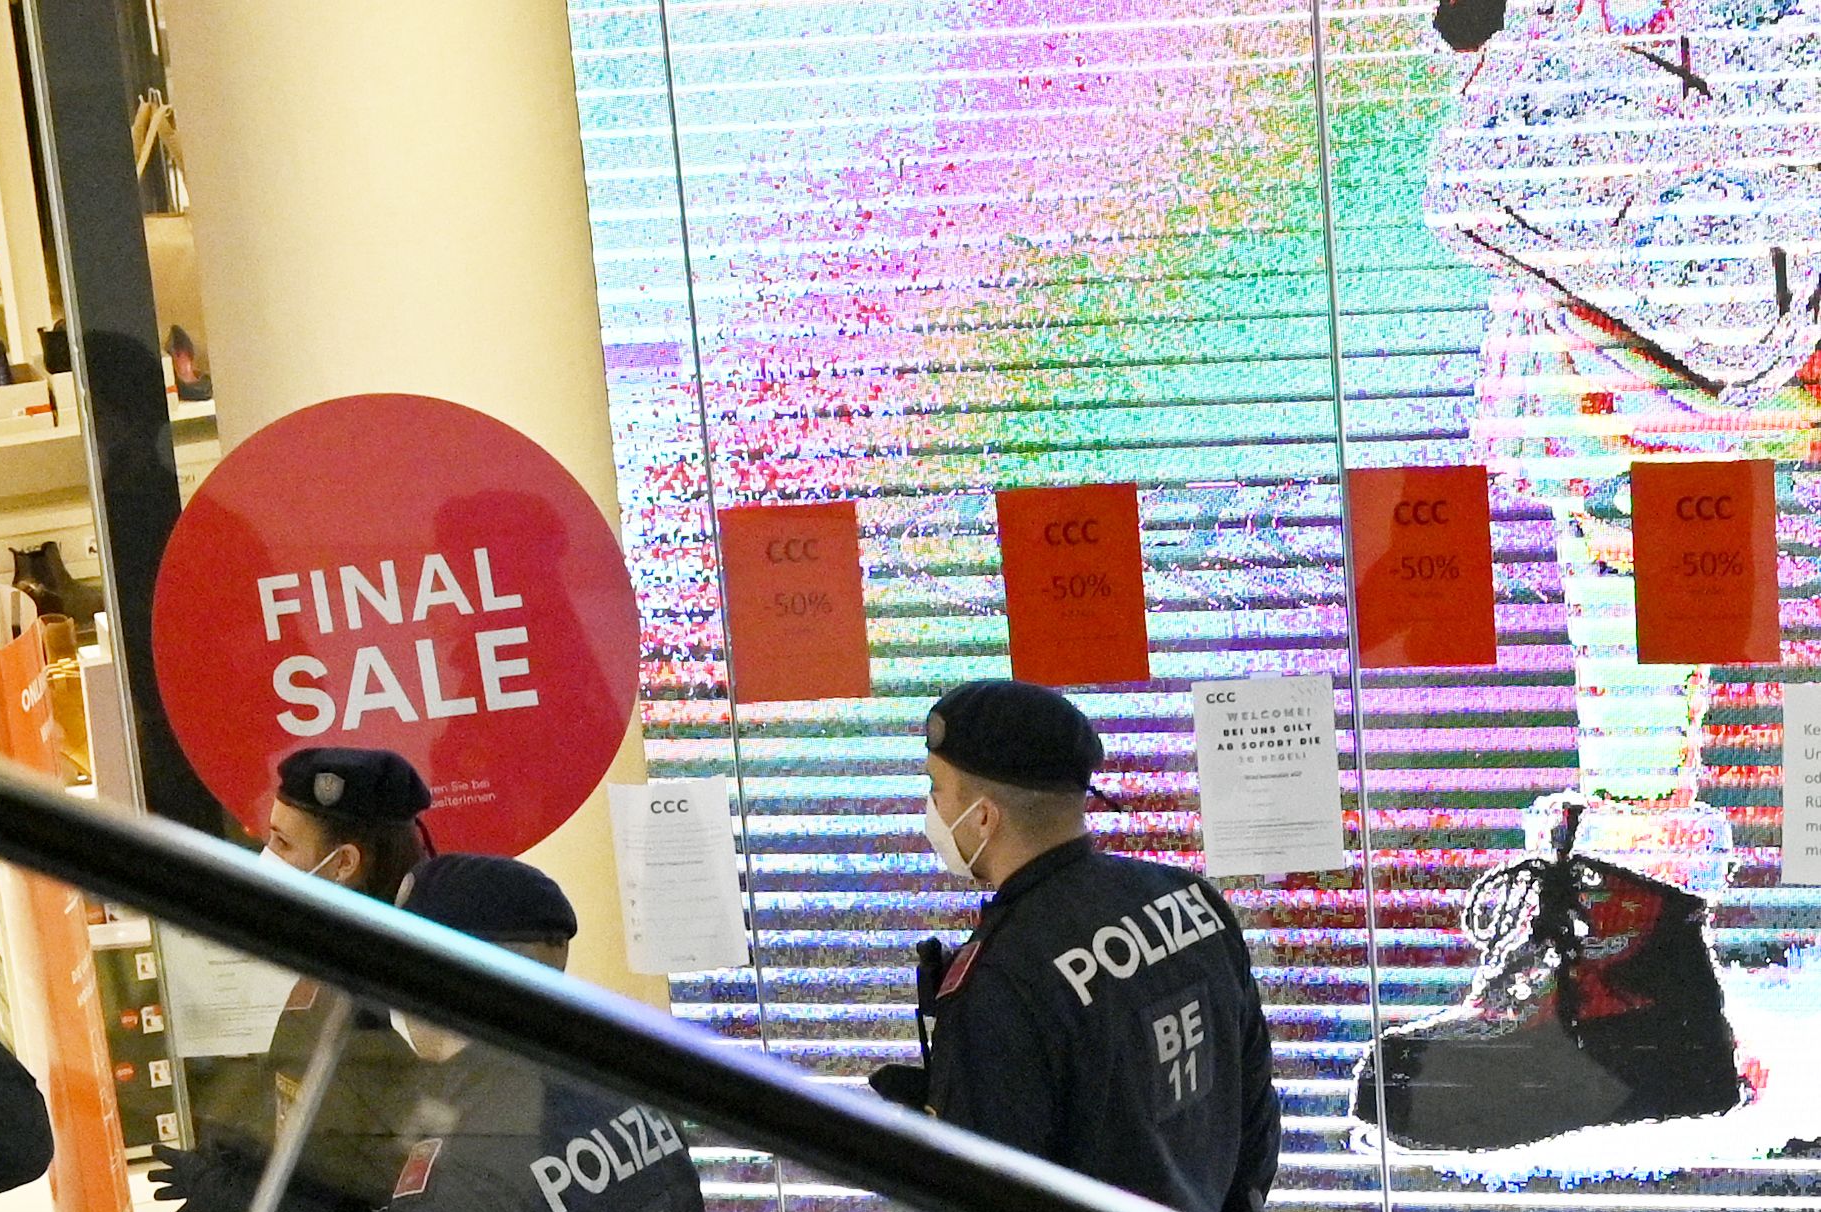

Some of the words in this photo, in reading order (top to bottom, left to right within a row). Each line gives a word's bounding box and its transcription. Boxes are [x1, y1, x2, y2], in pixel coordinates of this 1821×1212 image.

[1394, 500, 1449, 526] CCC
[1676, 496, 1732, 521] CCC
[1044, 519, 1098, 546] CCC
[766, 538, 820, 564] CCC
[1672, 551, 1743, 577] -50%
[1390, 554, 1460, 581] -50%
[257, 547, 523, 641] FINAL
[1042, 574, 1112, 601] -50%
[764, 593, 833, 617] -50%
[272, 626, 539, 737] SALE
[1206, 692, 1236, 703] CCC
[1227, 707, 1311, 721] WELCOME!
[1223, 728, 1243, 736] BEI
[1251, 726, 1276, 735] UNS
[1283, 723, 1312, 733] GILT
[1217, 742, 1234, 750] AB
[1241, 739, 1292, 749] SOFORT
[1300, 737, 1321, 746] DIE
[450, 780, 469, 792] Sie
[650, 799, 690, 814] CCC
[1053, 882, 1226, 1007] POLIZEI
[1152, 999, 1205, 1064] BE
[1168, 1050, 1197, 1101] 11
